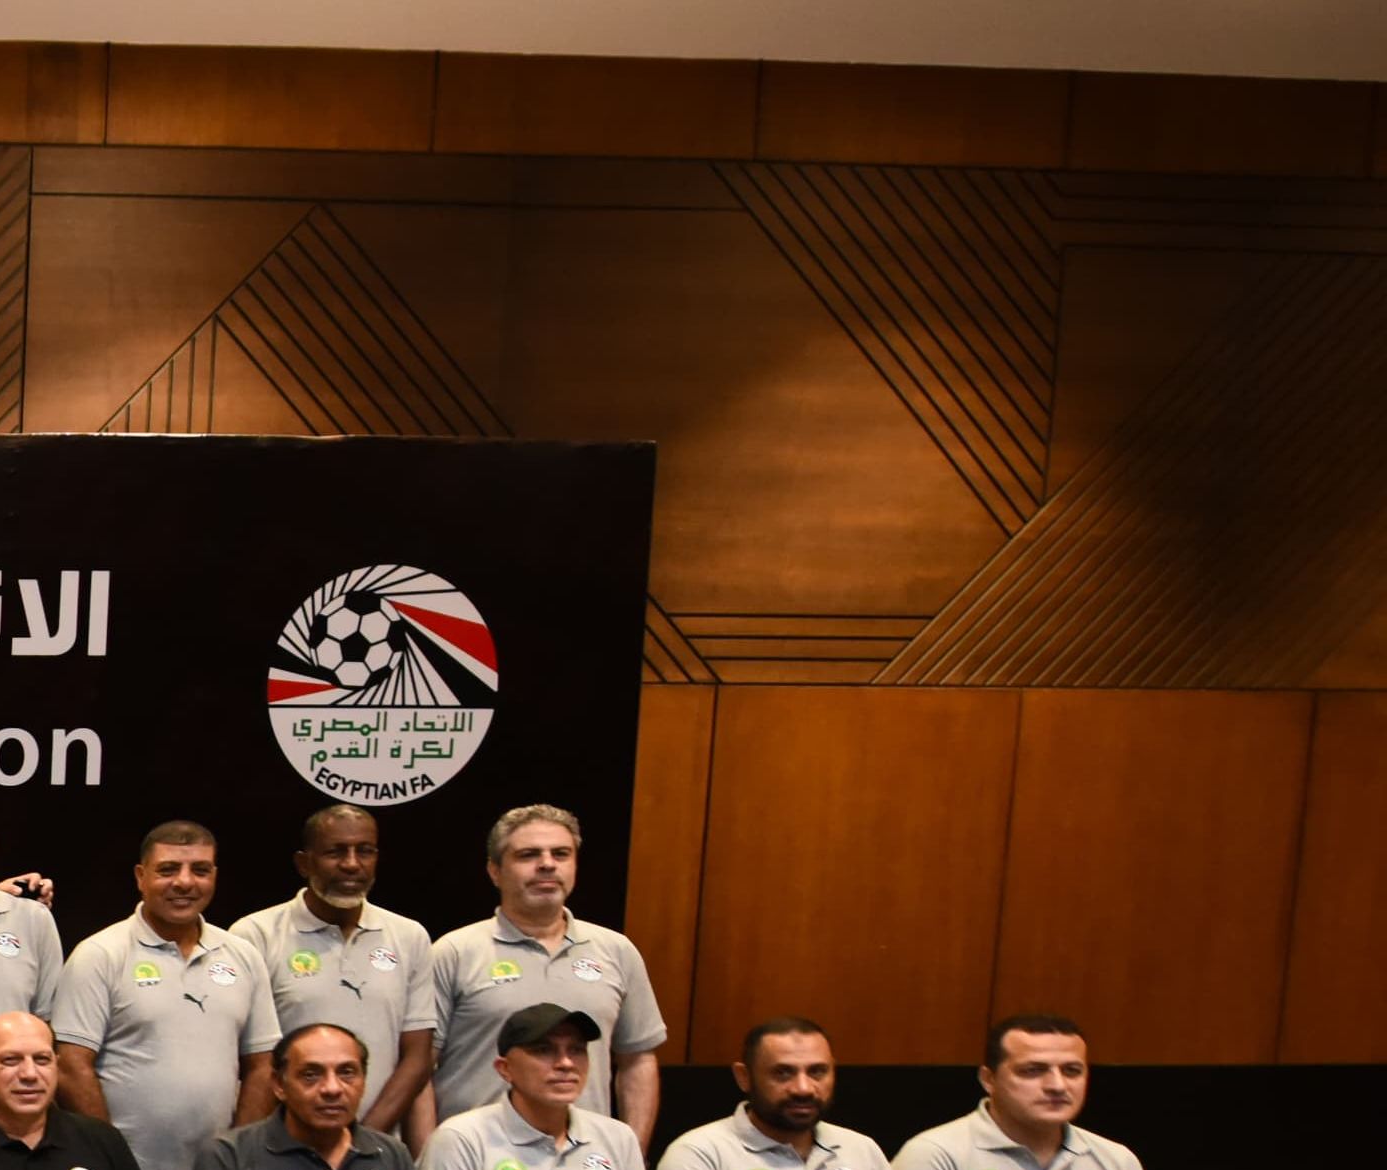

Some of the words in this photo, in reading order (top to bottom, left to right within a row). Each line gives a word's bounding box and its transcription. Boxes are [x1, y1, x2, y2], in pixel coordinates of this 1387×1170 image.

[292, 711, 388, 743] المصري
[399, 711, 473, 732] الاتحاد
[310, 738, 378, 772] القدم
[389, 738, 454, 769] لكرة
[314, 767, 407, 800] EGYPTIAN
[410, 773, 435, 794] FA
